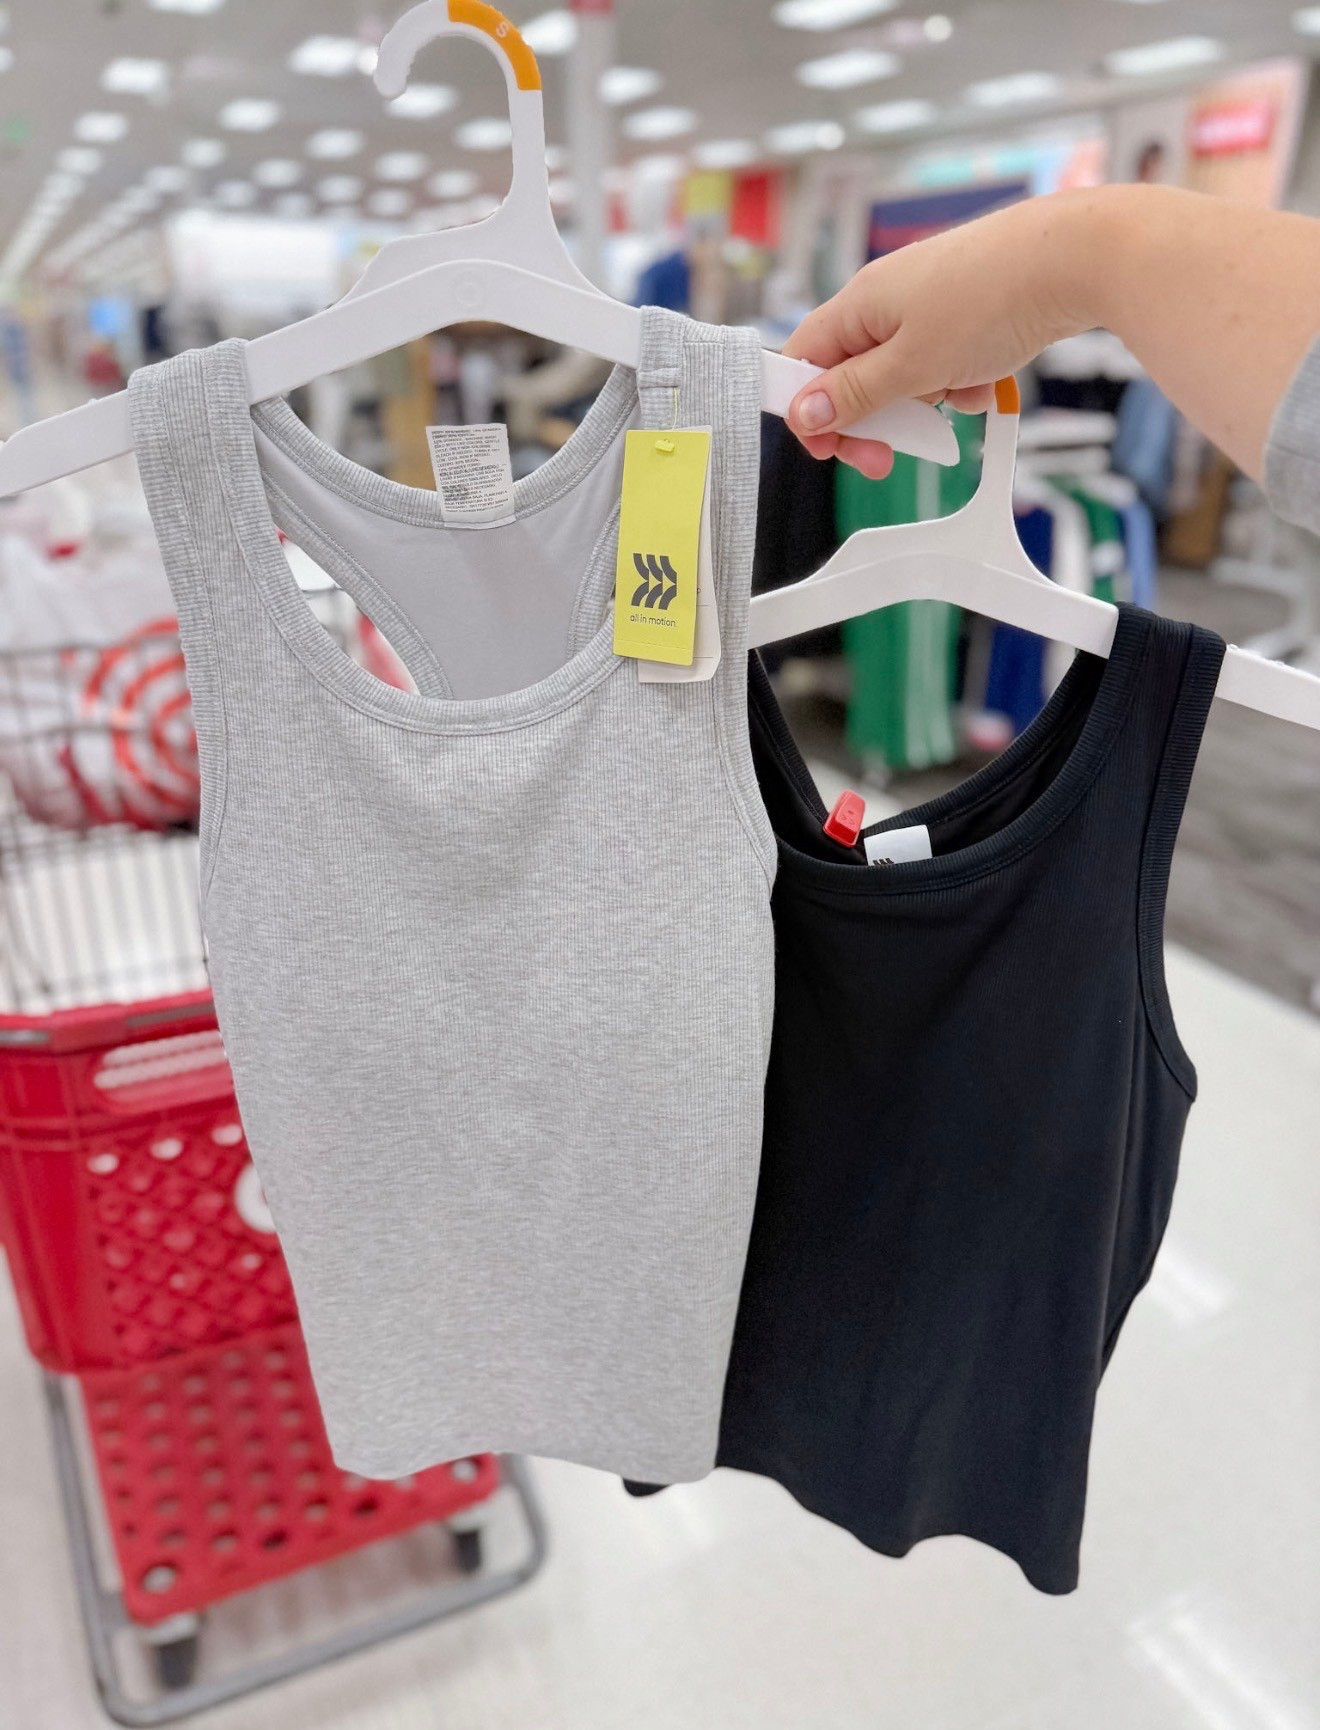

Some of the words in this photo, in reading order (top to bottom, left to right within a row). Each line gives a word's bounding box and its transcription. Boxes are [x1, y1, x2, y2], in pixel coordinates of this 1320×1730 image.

[495, 21, 510, 38] S
[629, 614, 639, 623] all
[639, 613, 647, 623] in
